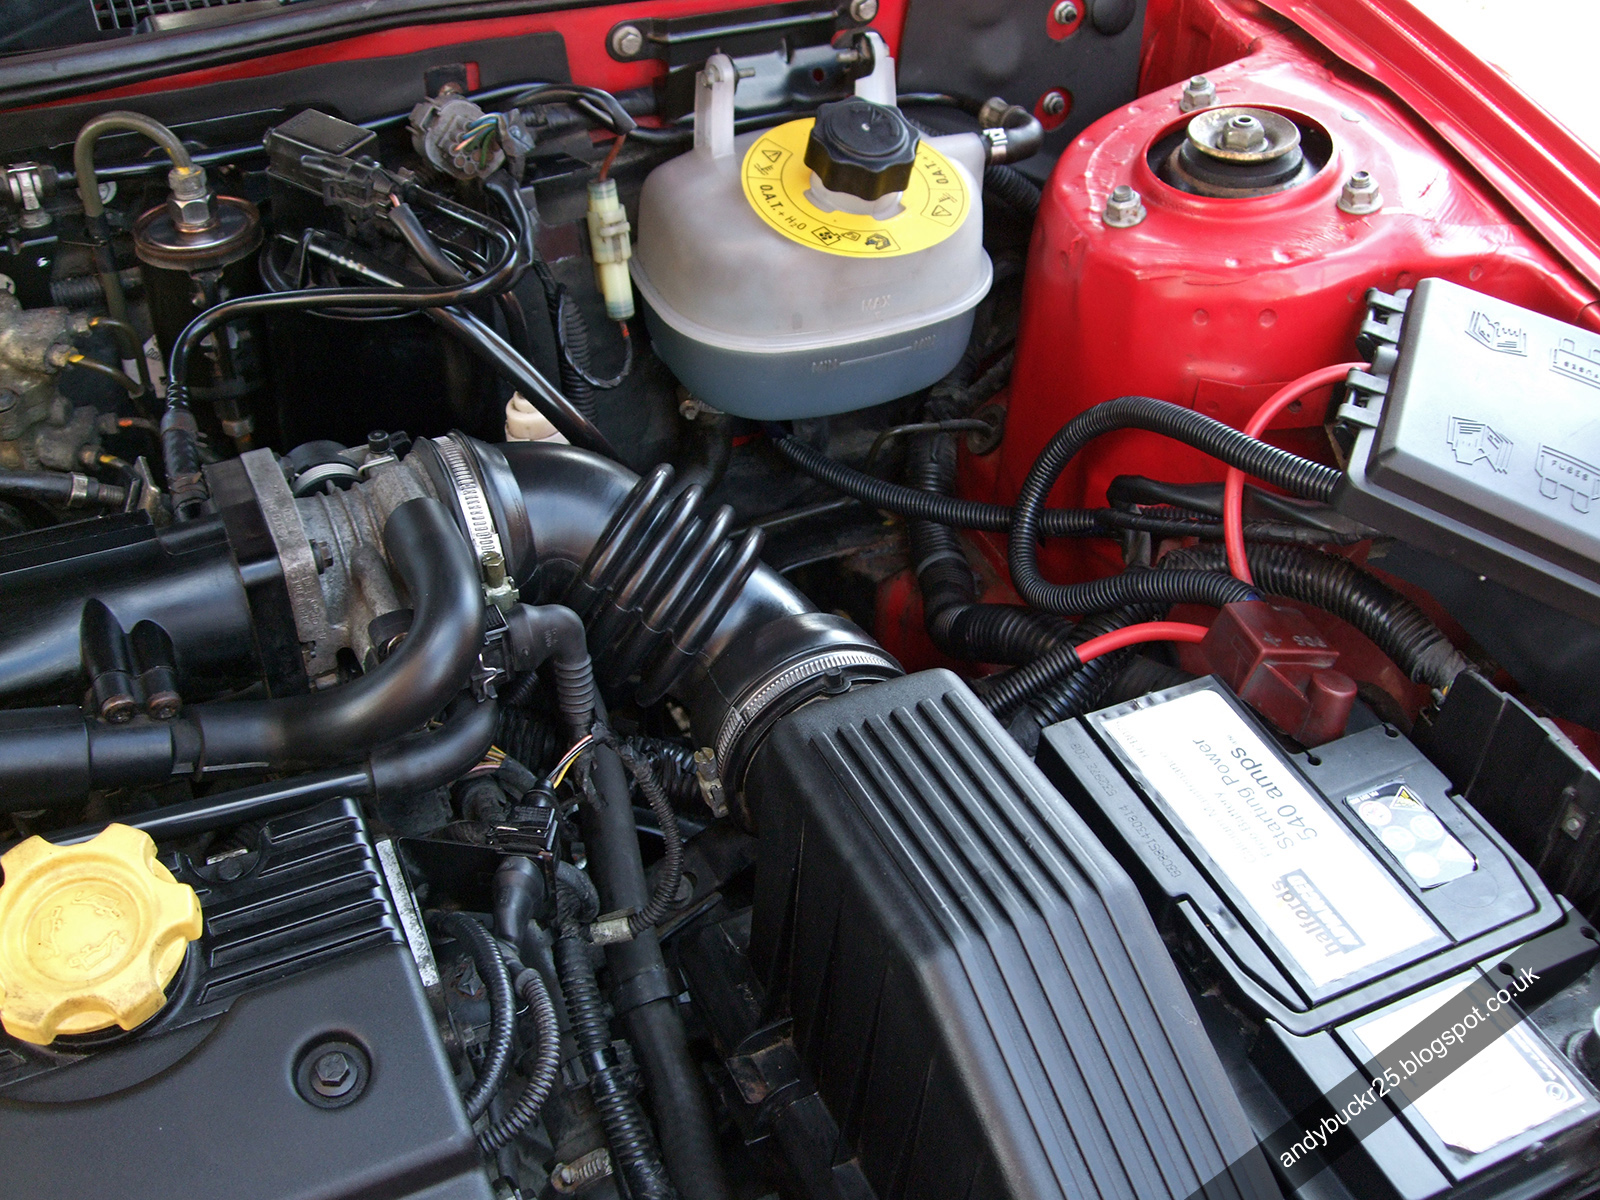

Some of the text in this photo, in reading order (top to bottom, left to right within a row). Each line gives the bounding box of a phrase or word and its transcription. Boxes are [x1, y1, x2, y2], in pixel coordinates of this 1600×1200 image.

[923, 161, 949, 184] O.A.T.
[760, 184, 784, 211] O.A.T.
[861, 294, 891, 312] MAX
[1551, 459, 1589, 481] FUSES
[1230, 746, 1284, 800] amps
[1192, 738, 1295, 850] Starting Power
[1213, 792, 1252, 832] Battery
[1276, 804, 1318, 841] 540
[1271, 877, 1342, 958] halfords
